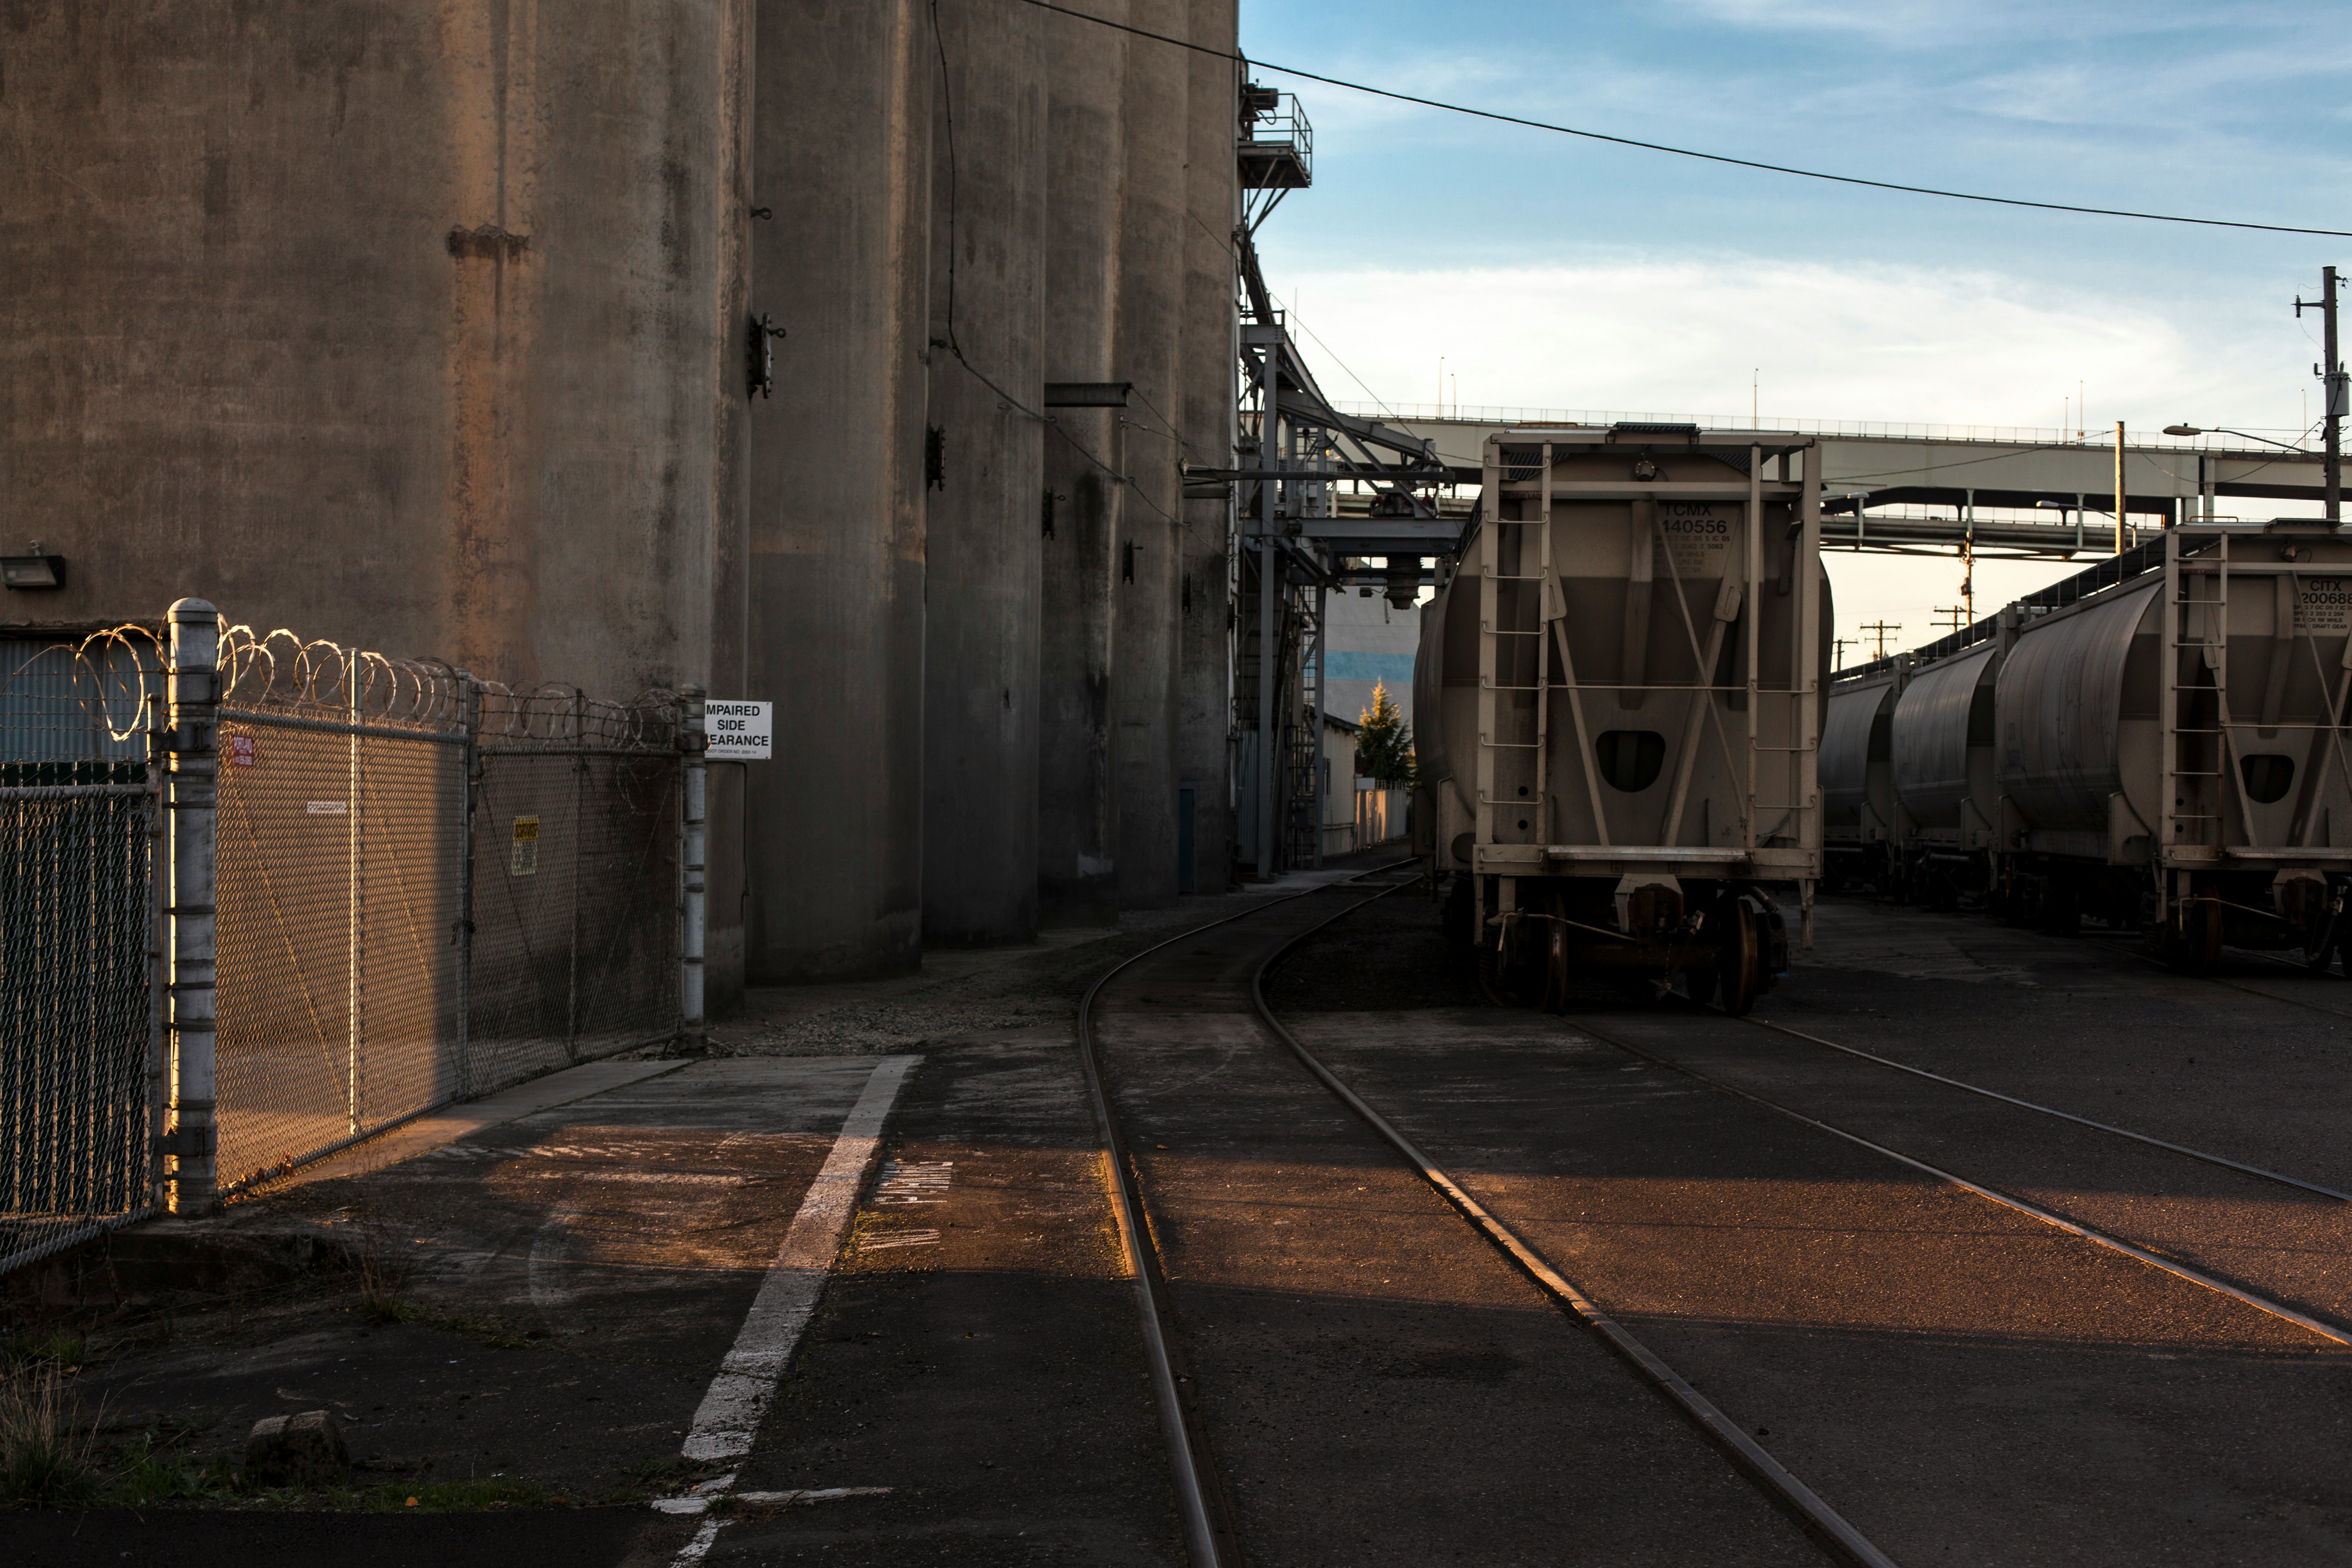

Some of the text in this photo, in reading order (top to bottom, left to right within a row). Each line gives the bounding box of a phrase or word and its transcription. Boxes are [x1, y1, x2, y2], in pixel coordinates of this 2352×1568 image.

[1663, 503, 1712, 516] TCMX
[1663, 520, 1726, 533] 140556
[2311, 580, 2342, 591] CITX
[707, 704, 760, 716] MPAIRED
[717, 720, 745, 730] SIDE
[710, 735, 769, 746] EARANCE
[873, 1161, 954, 1205] PARKING
